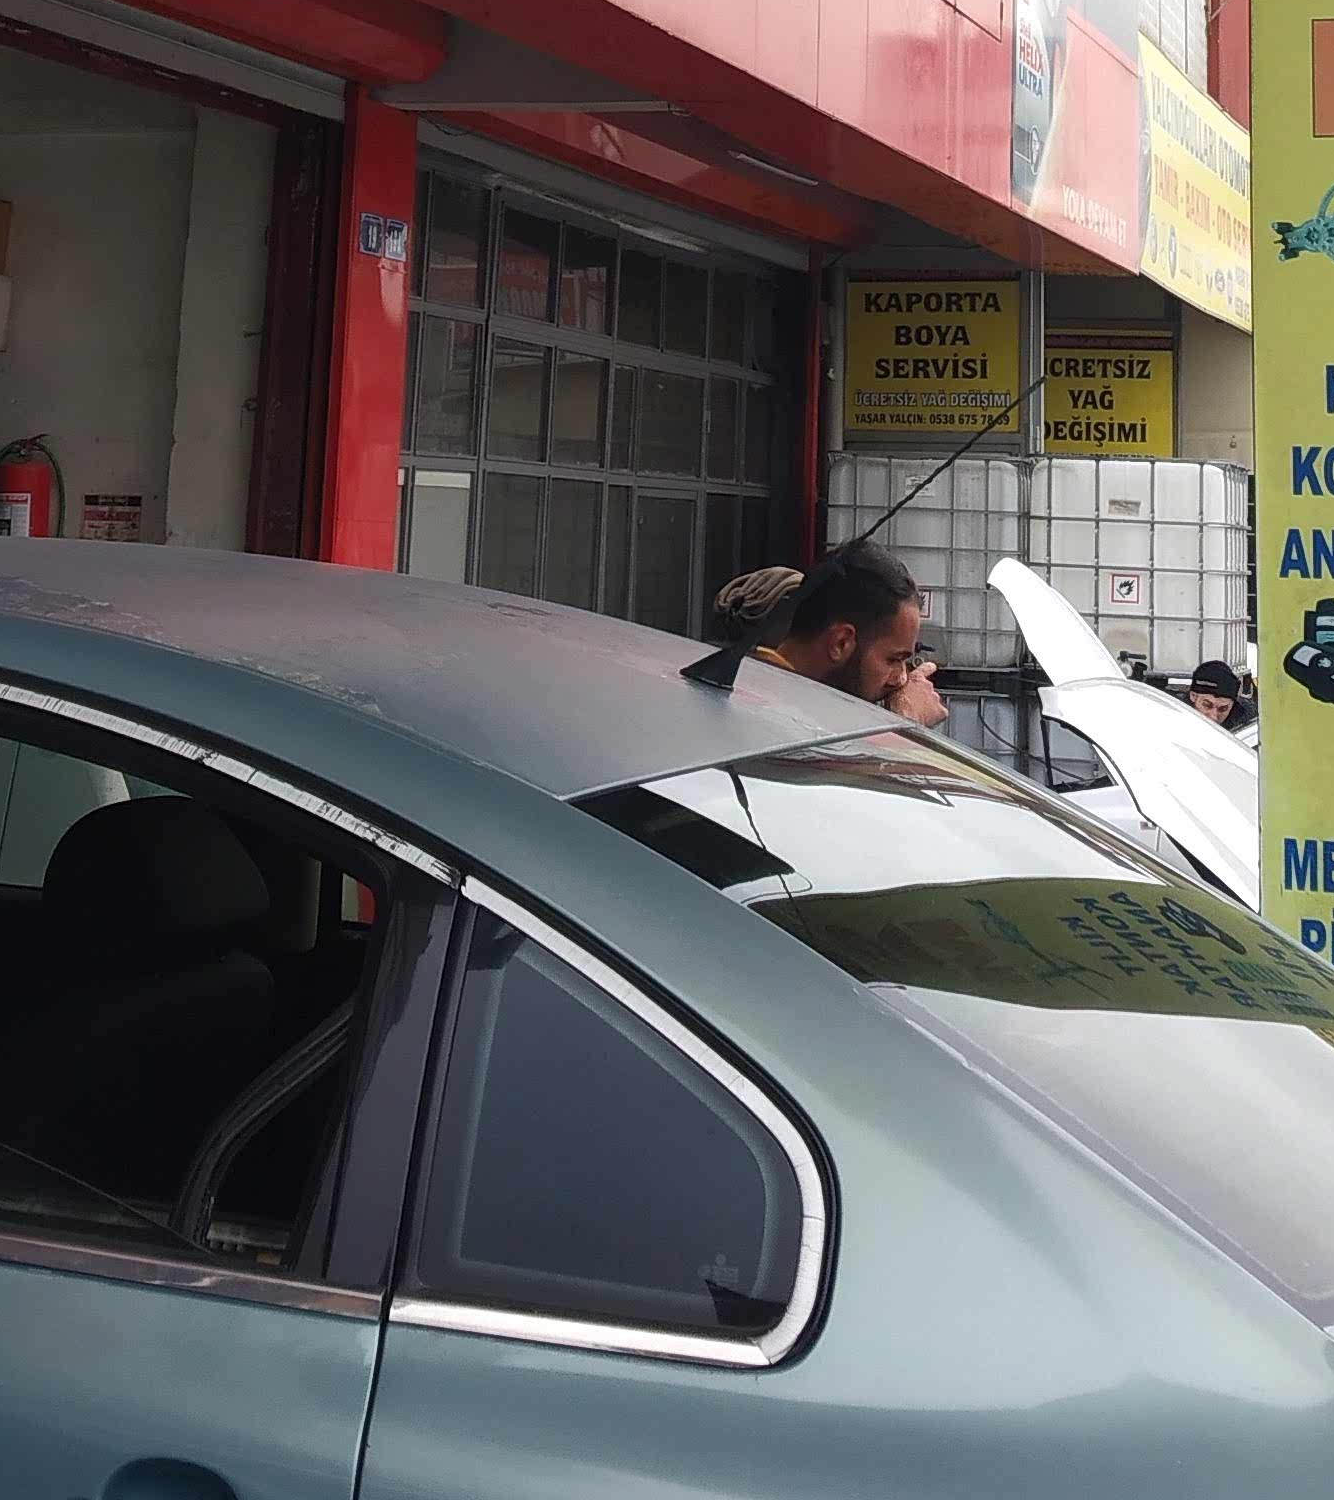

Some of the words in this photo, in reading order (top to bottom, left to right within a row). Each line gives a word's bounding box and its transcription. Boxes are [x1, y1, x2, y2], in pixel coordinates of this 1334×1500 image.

[865, 292, 1001, 313] KAPORTA
[894, 325, 970, 346] BOYA
[875, 353, 988, 379] SERVİSİ
[1044, 354, 1151, 379] CRETSİZ
[854, 389, 916, 407] ÜCRETSİZ
[921, 390, 946, 407] YAĞ
[1068, 385, 1114, 410] YAĞ
[929, 414, 955, 425] 0538
[958, 414, 978, 425] 675
